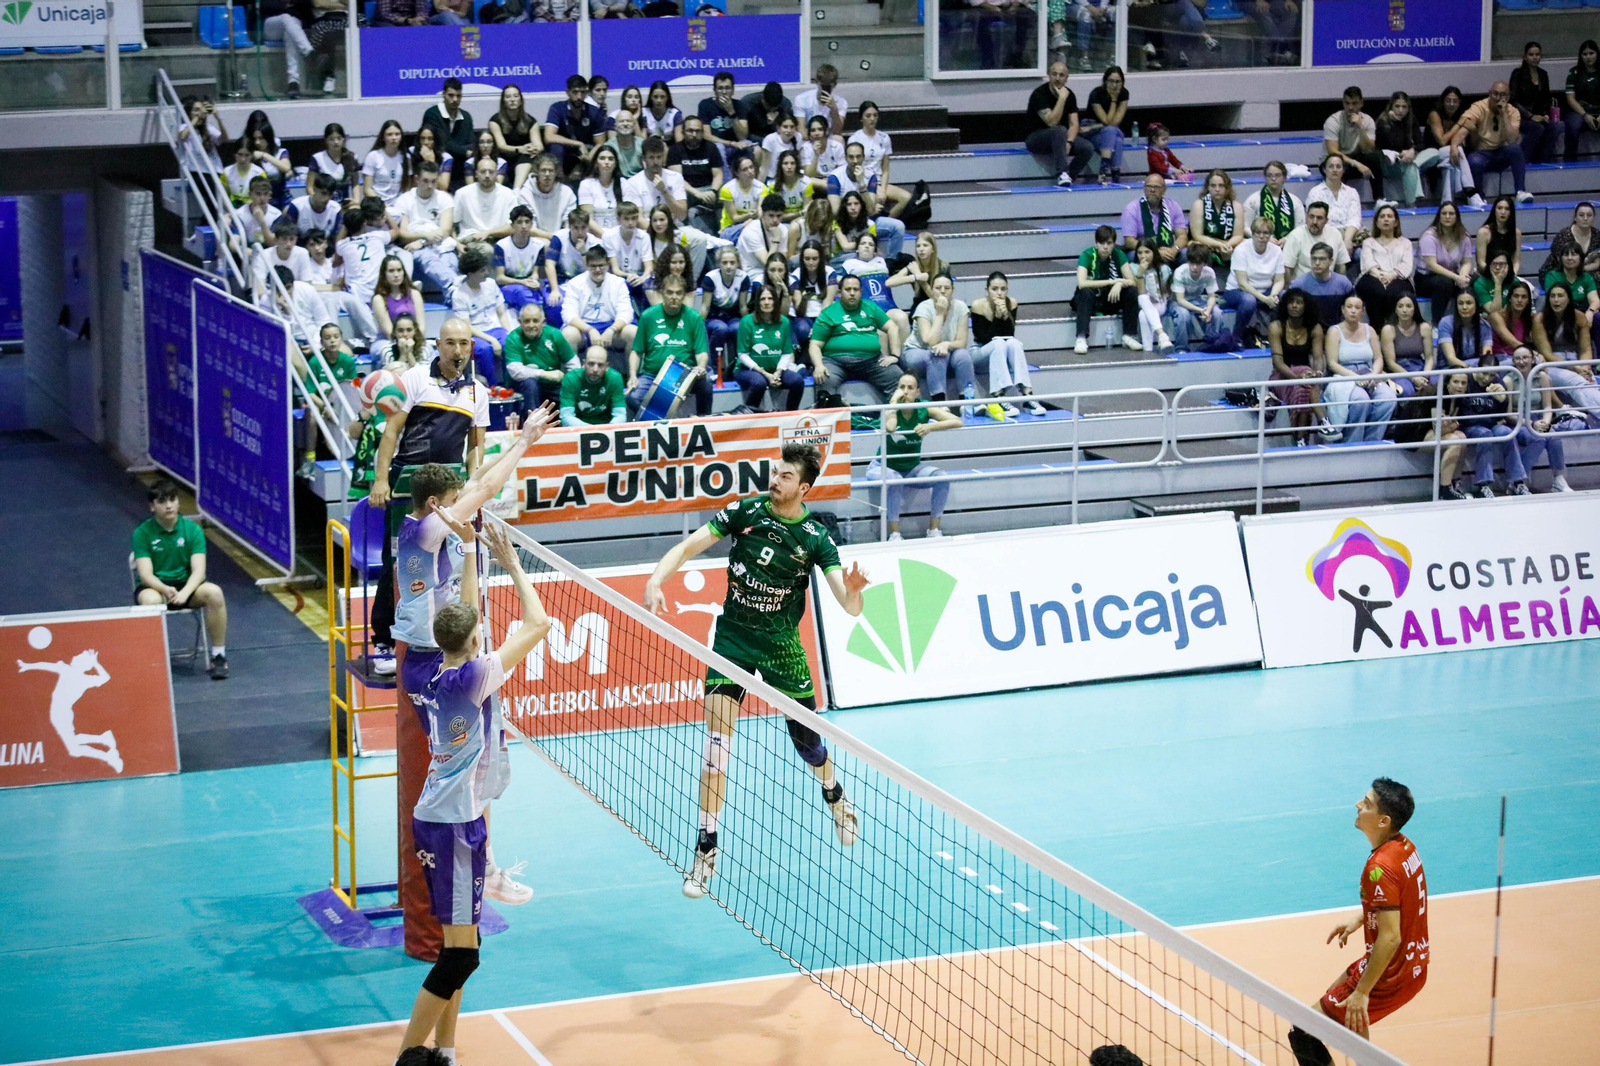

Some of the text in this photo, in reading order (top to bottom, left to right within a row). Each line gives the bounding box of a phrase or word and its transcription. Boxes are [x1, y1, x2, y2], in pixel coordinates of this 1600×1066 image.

[38, 5, 106, 25] Unicaja
[1336, 35, 1455, 50] DIPUTACIÓN DE ALMERÍA
[399, 63, 542, 79] DIPUTACIÓN DE ALMERÍA
[628, 55, 765, 71] DIPUTACIÓN DE ALMERÍA
[870, 149, 875, 158] 2
[743, 201, 751, 209] 21
[788, 196, 797, 205] 10
[357, 244, 370, 262] 2
[580, 421, 715, 467] PEÑA
[526, 459, 770, 511] LA UNION
[756, 546, 775, 566] 9
[1427, 551, 1595, 592] COSTA DE
[977, 572, 1228, 652] Unicaja
[1400, 585, 1600, 650] ALMERÍA
[514, 689, 599, 719] VOLEIBOL
[603, 678, 705, 709] MASCULINA
[1416, 872, 1426, 916] 5
